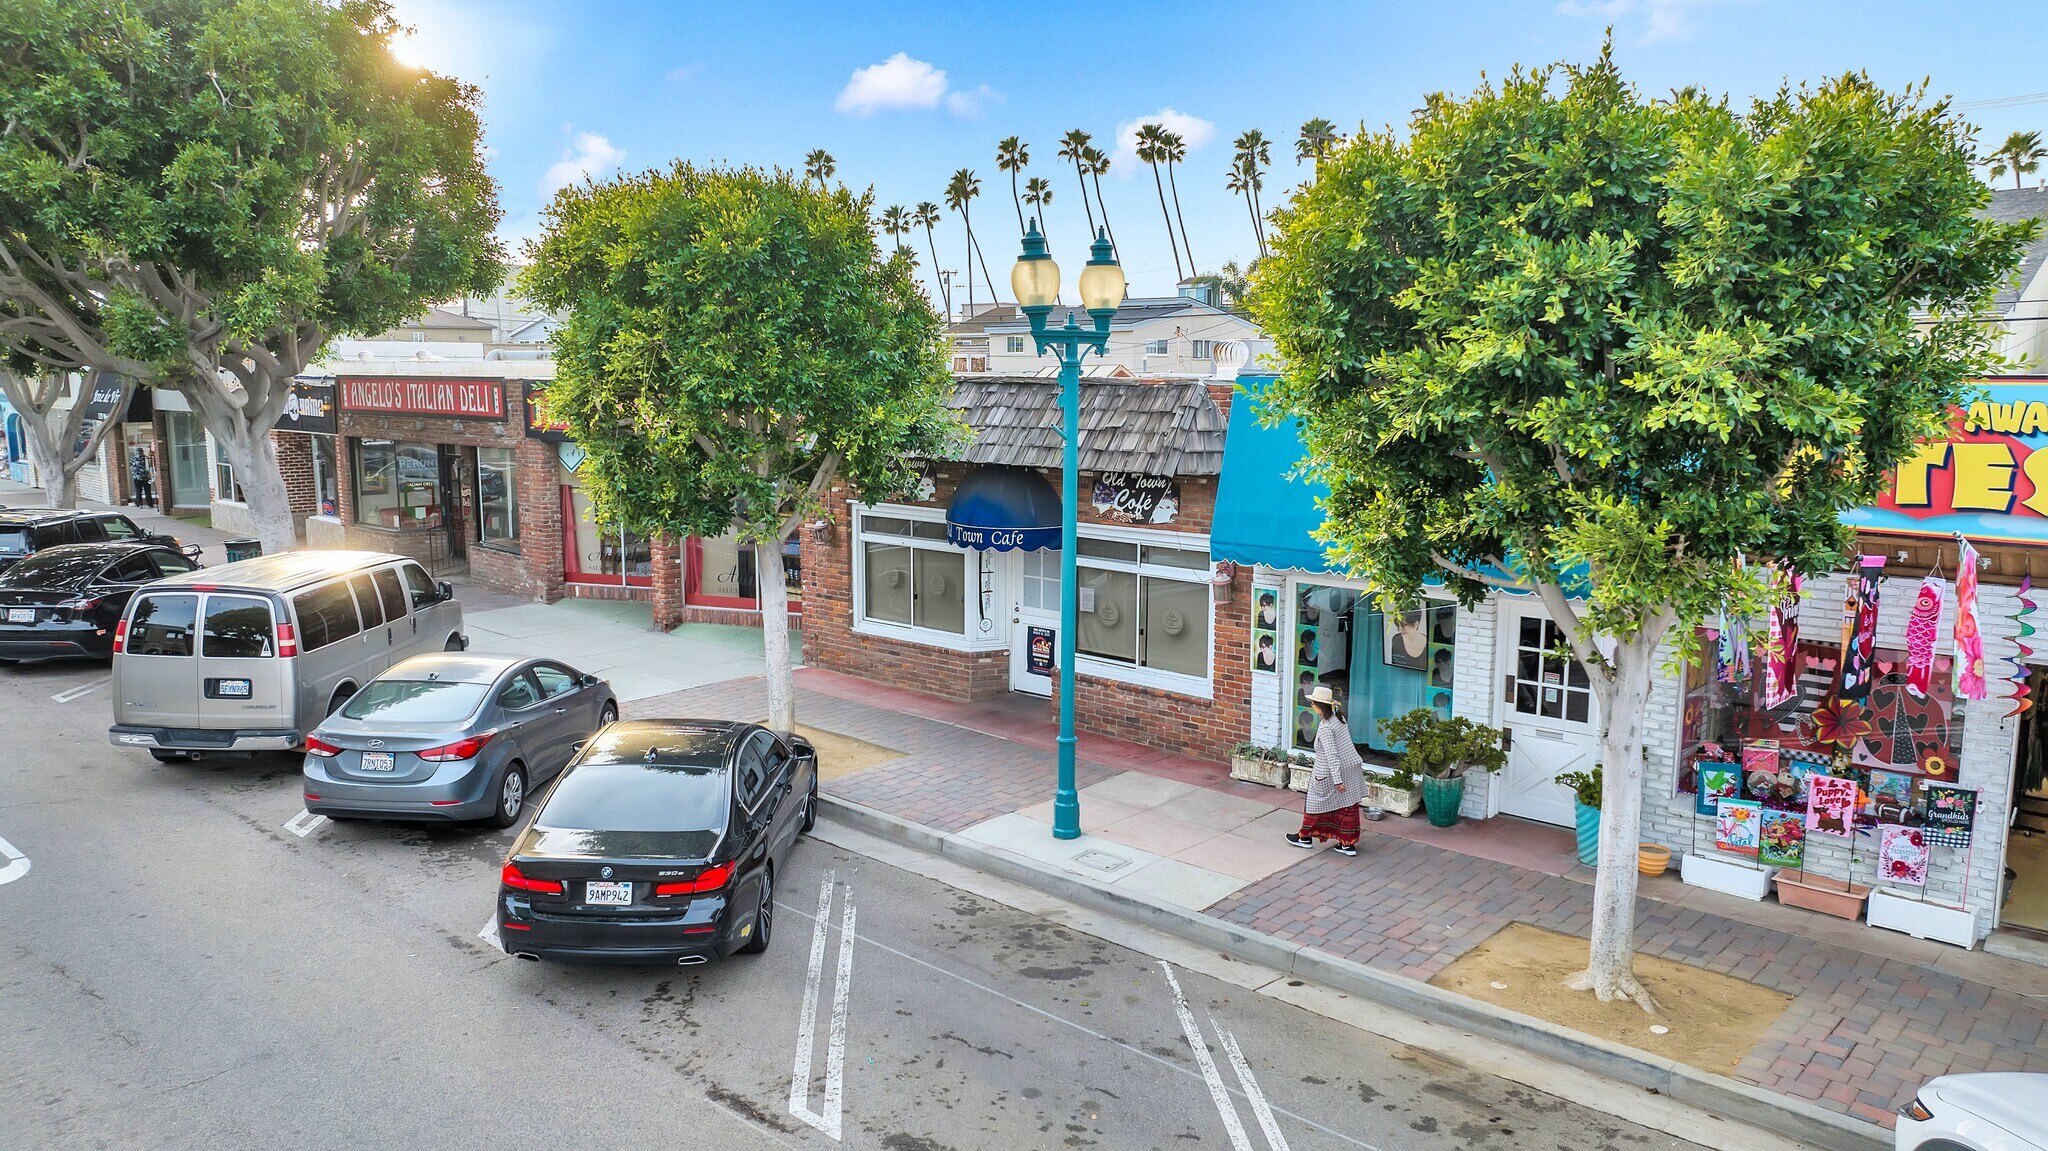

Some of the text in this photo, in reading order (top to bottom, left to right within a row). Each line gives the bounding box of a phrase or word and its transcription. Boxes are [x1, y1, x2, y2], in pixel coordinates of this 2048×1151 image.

[352, 382, 489, 413] ANGELO'S ITALIAN DELI
[399, 458, 438, 468] PERONI
[1102, 471, 1167, 489] Old Town
[956, 526, 984, 544] Town
[991, 530, 1024, 546] Cafe
[1816, 788, 1846, 798] Puppy
[1819, 797, 1841, 805] Love
[1928, 809, 1969, 821] Grandkids
[589, 889, 629, 901] 9AMP942
